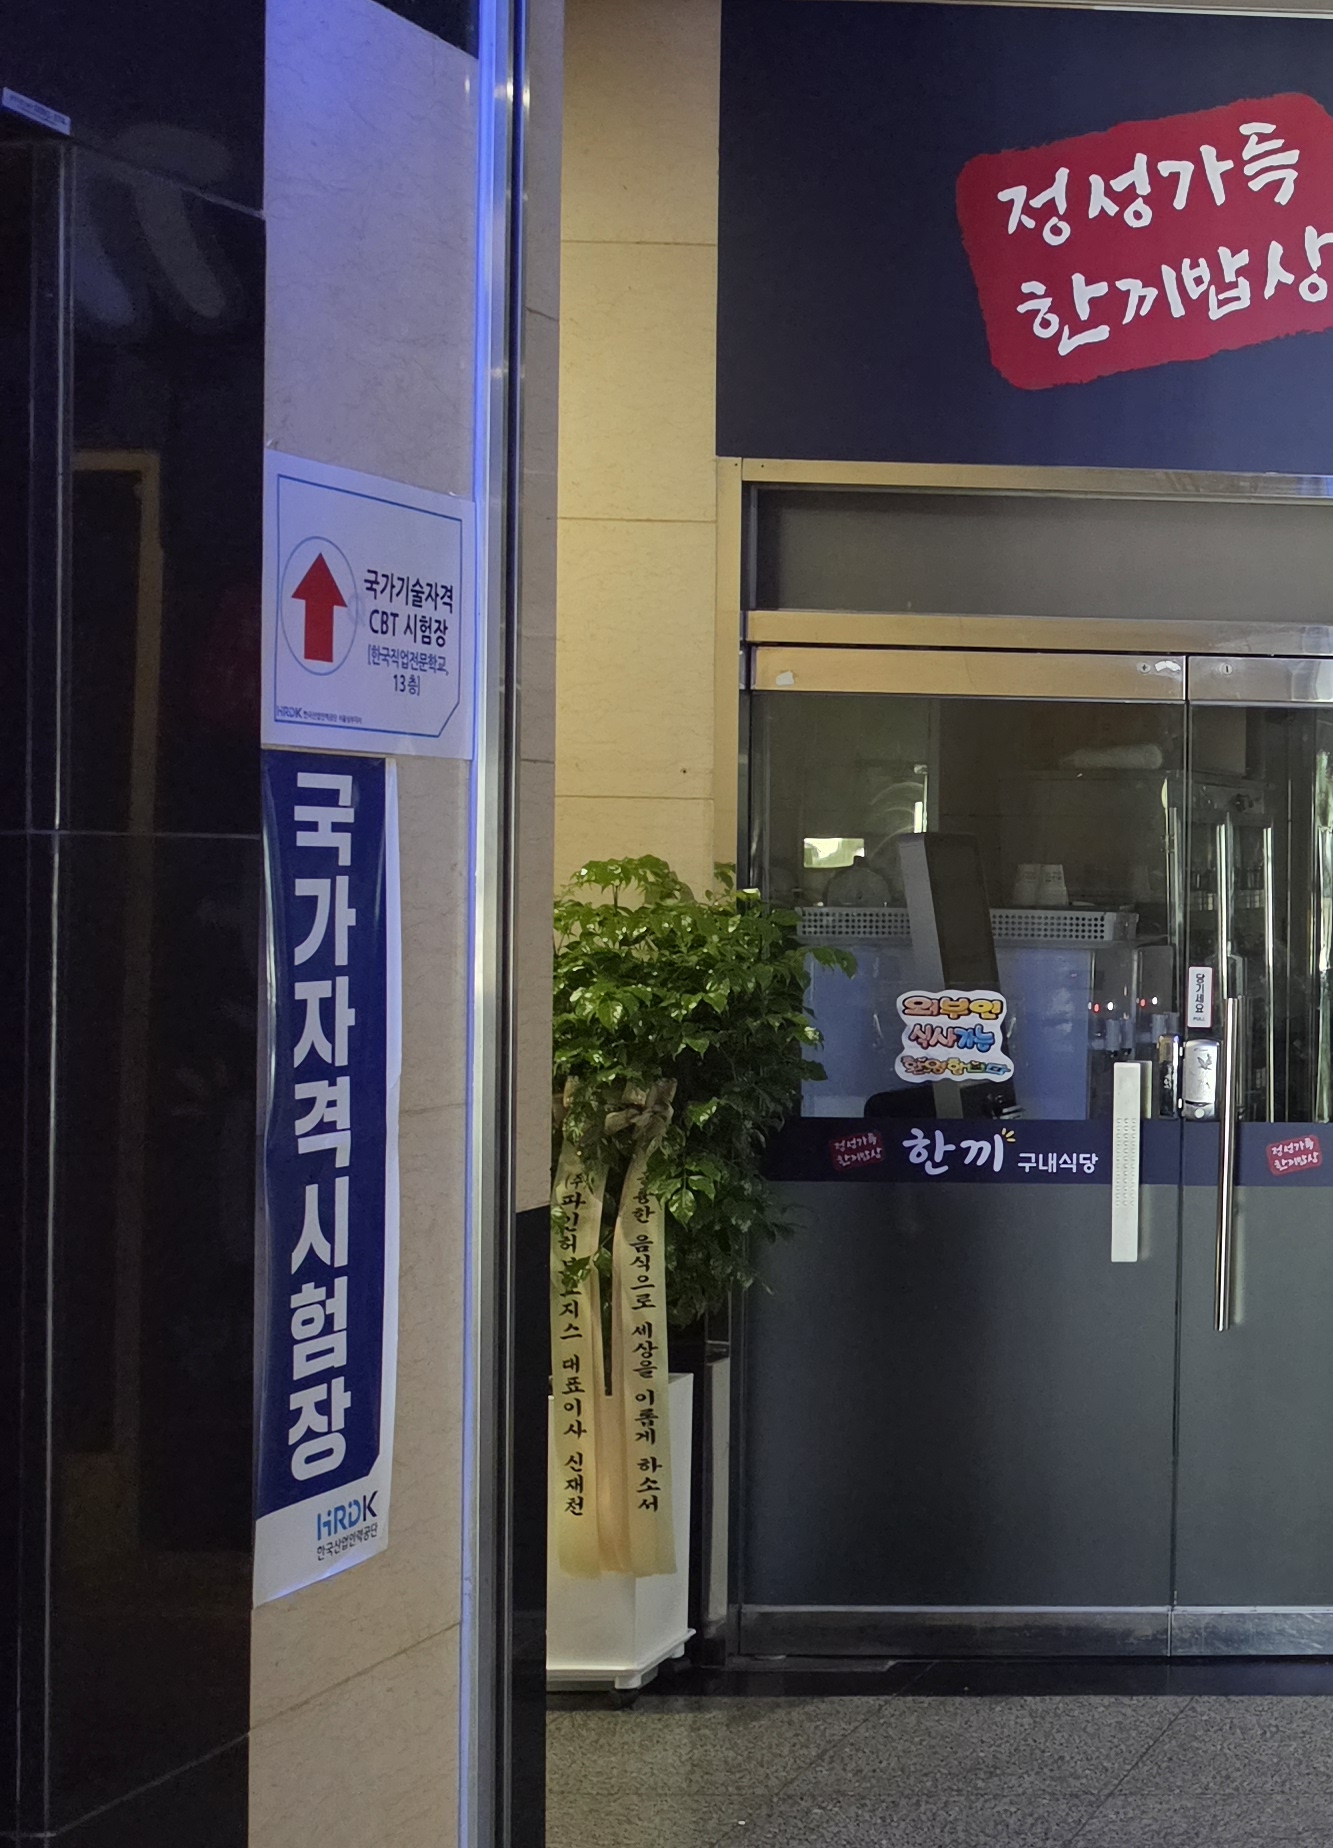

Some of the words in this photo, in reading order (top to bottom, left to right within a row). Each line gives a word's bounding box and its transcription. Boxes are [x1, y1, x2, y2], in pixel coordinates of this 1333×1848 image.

[997, 121, 1300, 246] 정성가득
[363, 568, 454, 614] 국가기술자격
[369, 609, 399, 636] CBT
[403, 612, 449, 647] 시험장
[902, 995, 1004, 1020] 외부인
[1195, 972, 1206, 1014] 당기세요
[908, 1023, 996, 1053] 식사가능
[901, 1055, 1012, 1076] 환영합니다
[287, 771, 357, 1482] 국가자격시험장
[902, 1127, 1004, 1175] 한끼
[1017, 1152, 1099, 1174] 구내식당
[630, 1233, 657, 1310] 음식으로
[631, 1321, 659, 1379] 세상을
[561, 1353, 588, 1440] 대표이사
[634, 1389, 659, 1445] 이롭게
[564, 1451, 585, 1516] 신재천
[637, 1455, 662, 1513] 하소서
[316, 1490, 379, 1541] HRDK
